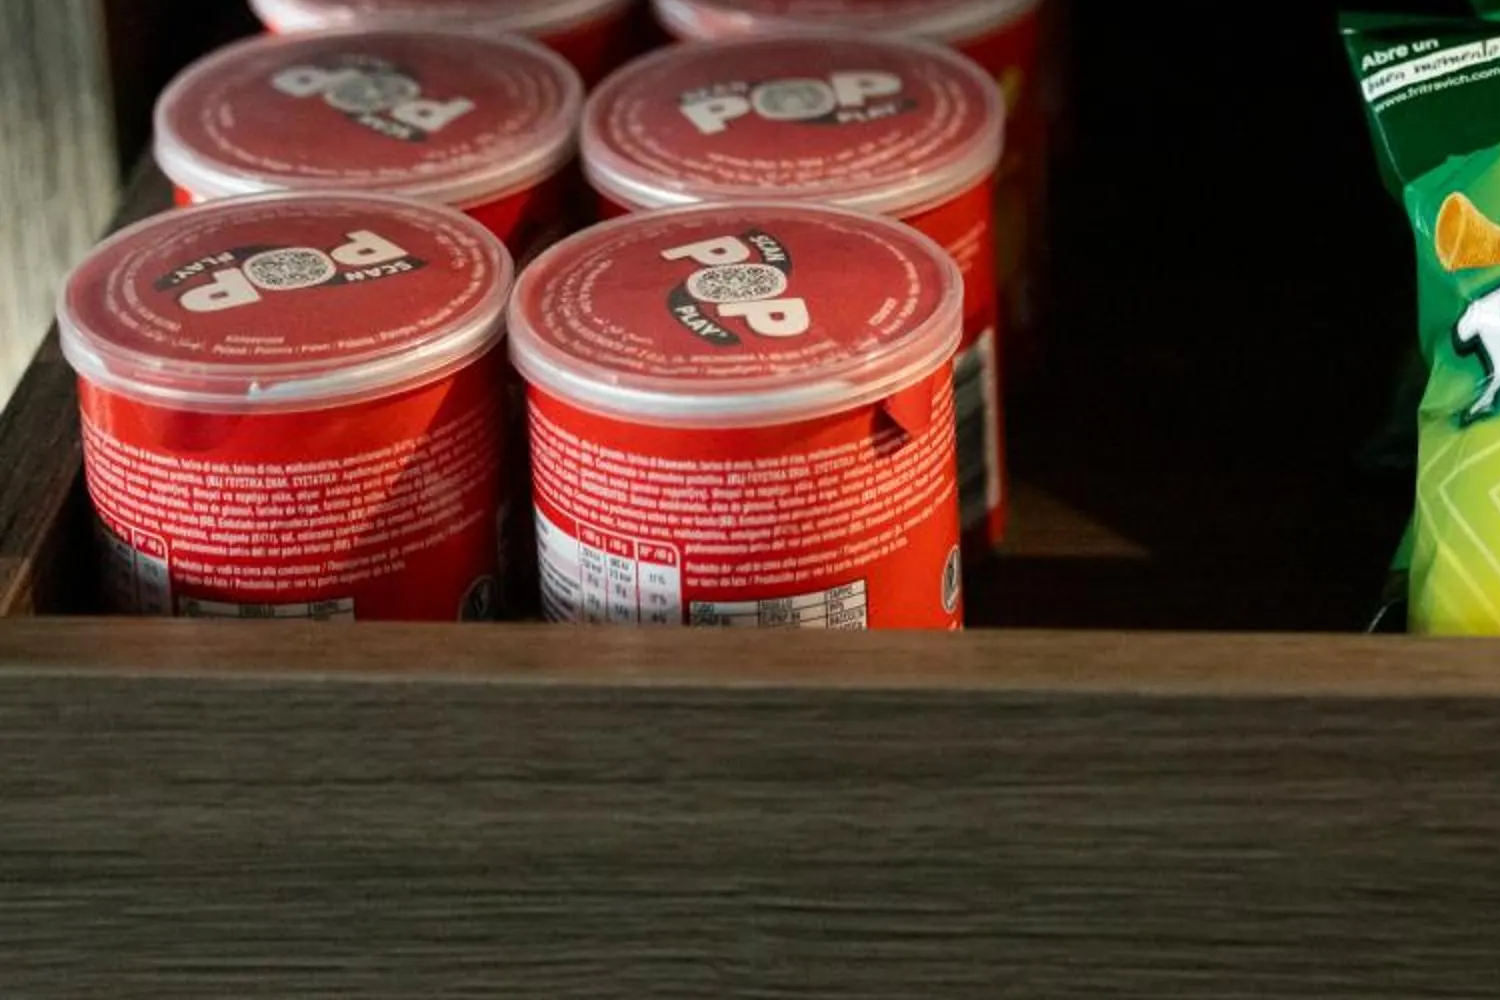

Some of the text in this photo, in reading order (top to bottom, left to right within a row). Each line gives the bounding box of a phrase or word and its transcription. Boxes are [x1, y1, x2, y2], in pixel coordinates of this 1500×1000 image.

[1361, 38, 1440, 71] Abre un
[749, 235, 786, 262] SCAN
